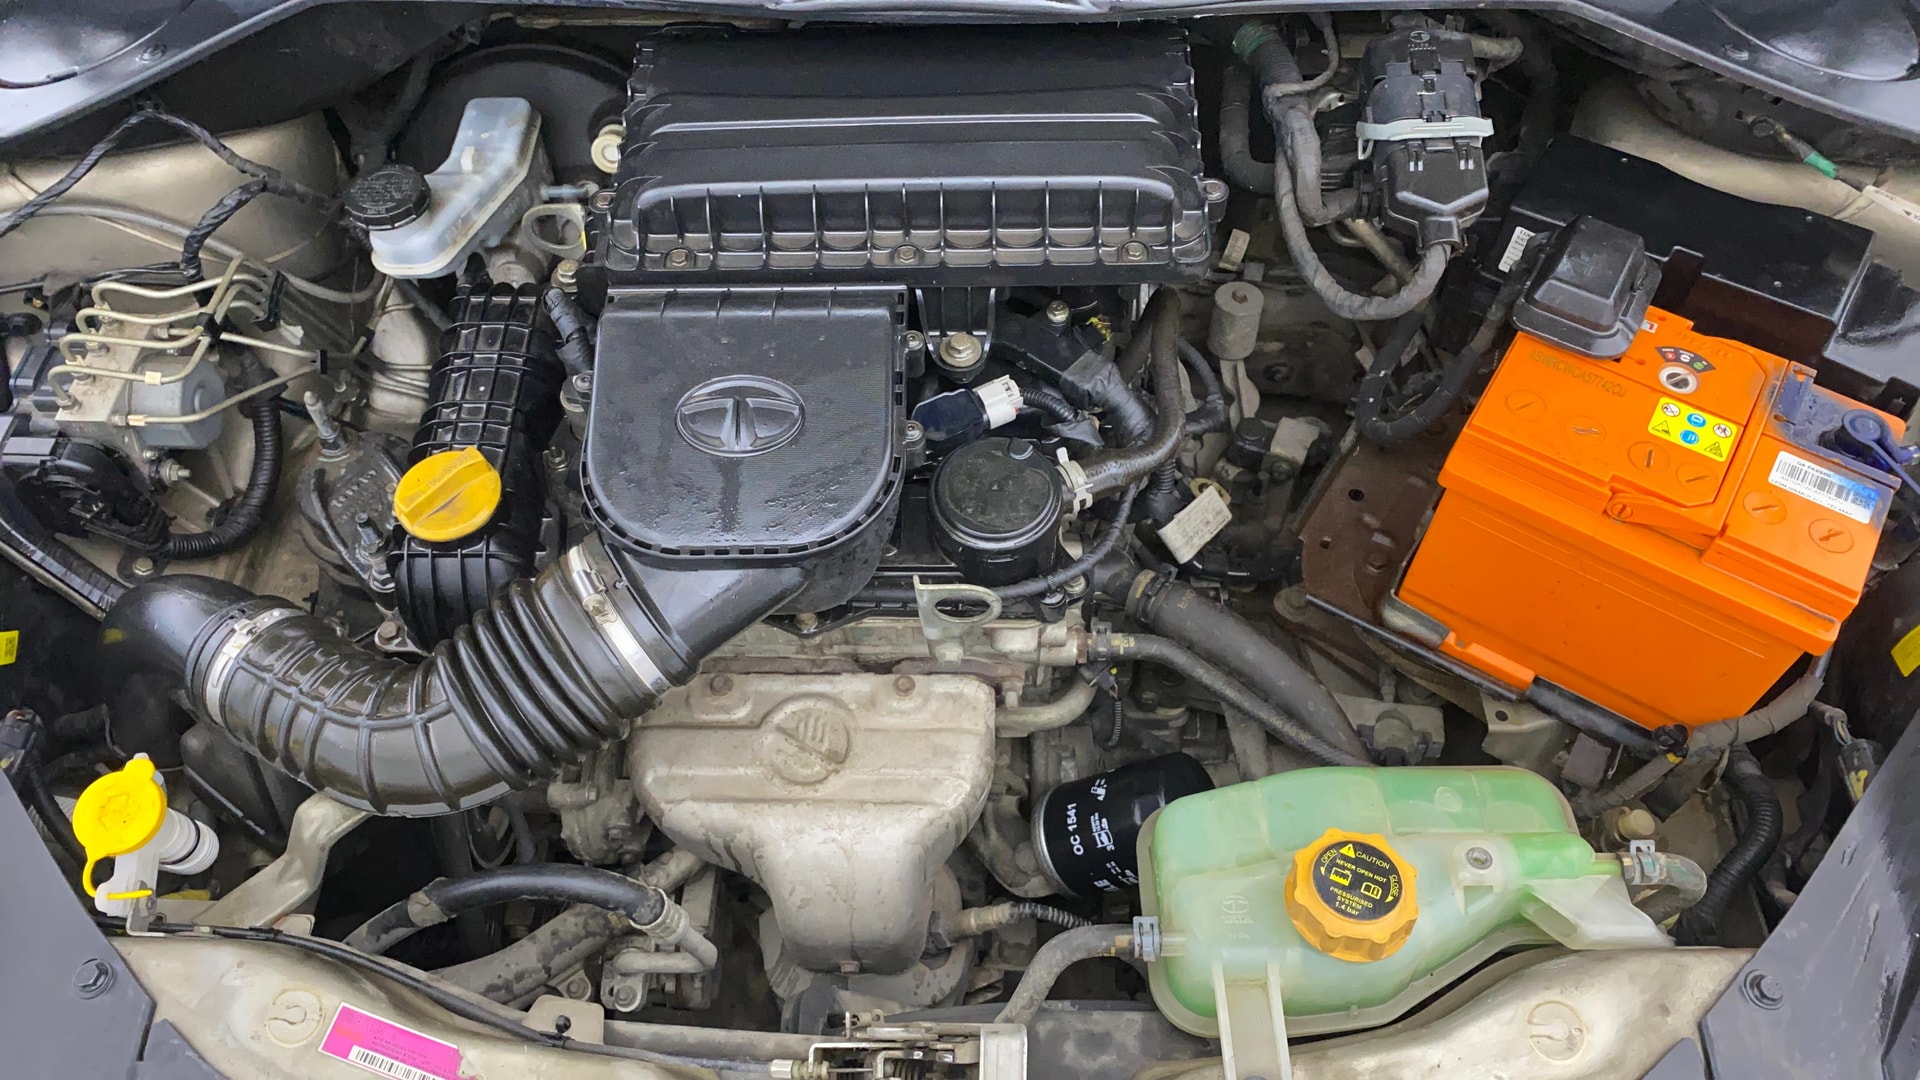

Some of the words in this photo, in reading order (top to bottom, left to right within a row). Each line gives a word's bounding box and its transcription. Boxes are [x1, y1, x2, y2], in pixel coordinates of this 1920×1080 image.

[1067, 803, 1077, 831] 1541
[1070, 835, 1084, 855] OC
[1321, 848, 1337, 863] OPEN
[1356, 851, 1390, 869] CAUTION
[1336, 858, 1356, 870] NEVER
[1356, 867, 1374, 878] OPEN
[1374, 875, 1387, 883] HOT
[1390, 875, 1399, 897] CLOSE
[1330, 886, 1373, 908] PRESSURISED
[1337, 896, 1362, 909] SYSTEM
[1336, 902, 1346, 910] 1.4
[1347, 906, 1359, 915] bar
